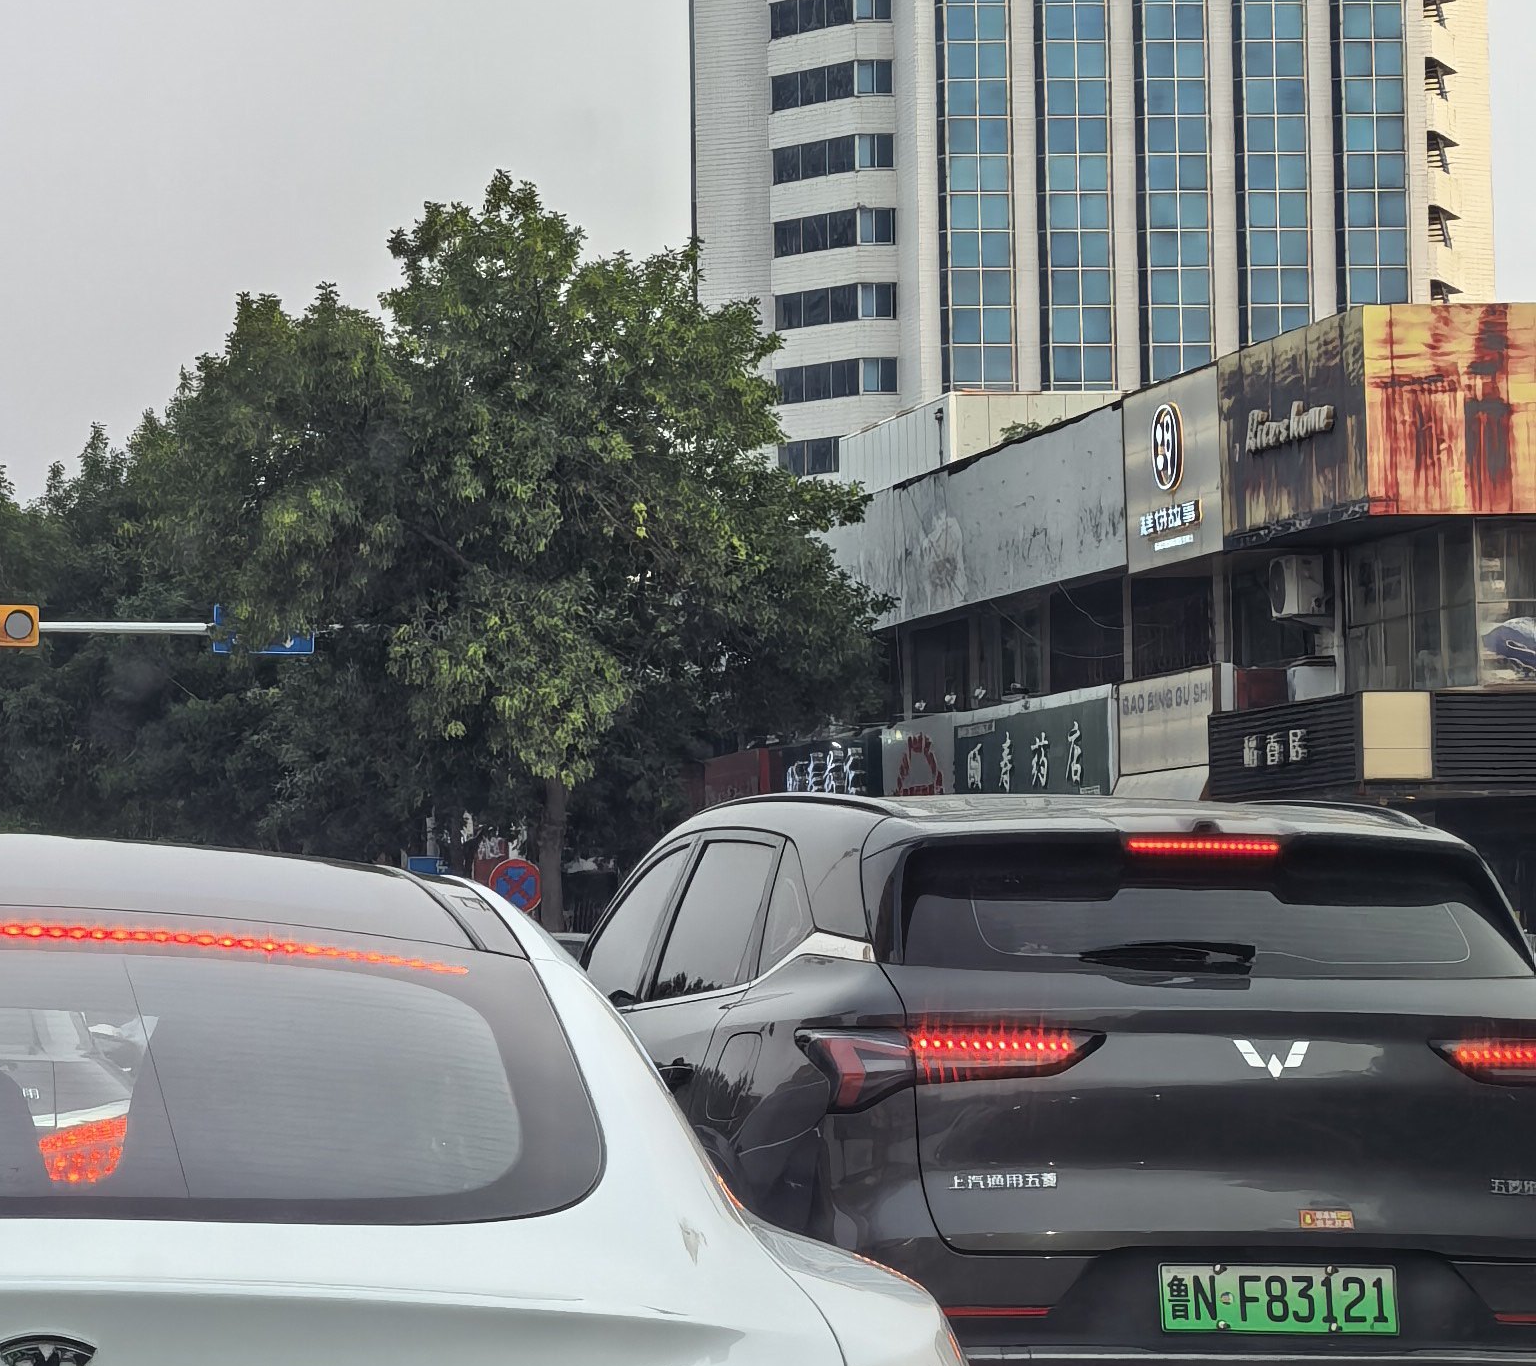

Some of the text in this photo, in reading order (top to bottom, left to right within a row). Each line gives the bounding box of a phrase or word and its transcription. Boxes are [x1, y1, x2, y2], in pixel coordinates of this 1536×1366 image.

[948, 1172, 1057, 1190] 上汽通用五菱
